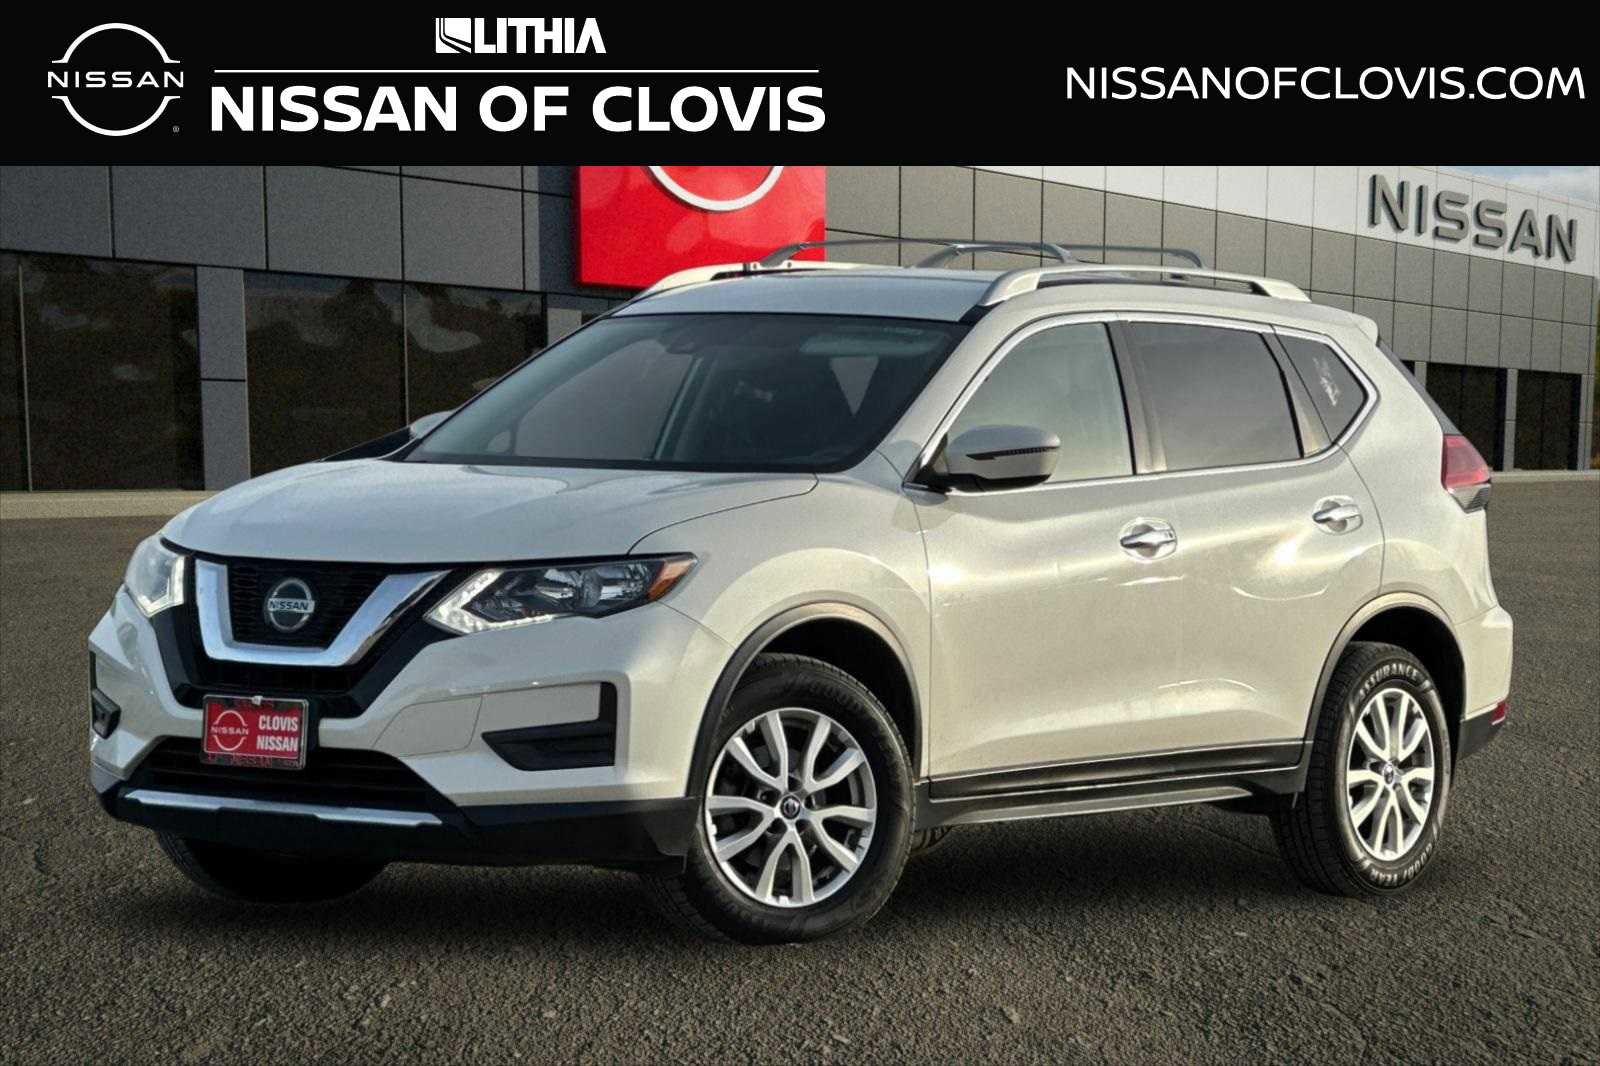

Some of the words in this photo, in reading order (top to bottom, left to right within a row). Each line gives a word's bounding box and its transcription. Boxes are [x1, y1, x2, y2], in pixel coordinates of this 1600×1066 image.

[1368, 174, 1578, 262] NISSAN
[269, 600, 309, 611] NISSAN
[1359, 663, 1419, 700] ASSURANCE
[210, 725, 249, 736] NISSAN
[258, 715, 299, 732] CLOVIS
[256, 735, 299, 752] NISSAN
